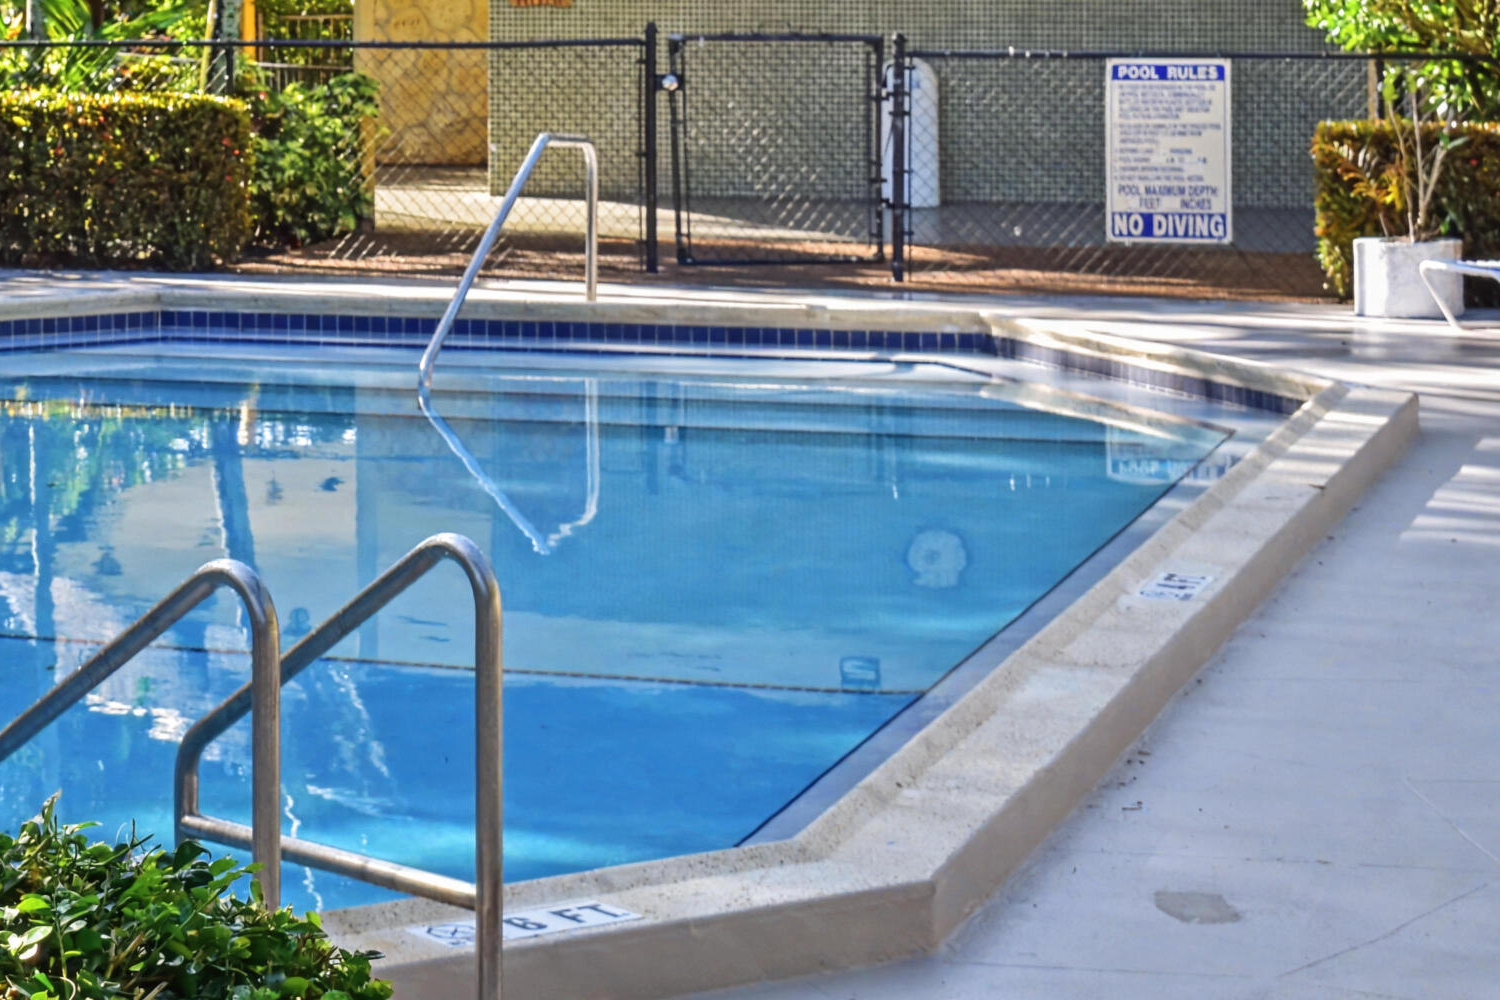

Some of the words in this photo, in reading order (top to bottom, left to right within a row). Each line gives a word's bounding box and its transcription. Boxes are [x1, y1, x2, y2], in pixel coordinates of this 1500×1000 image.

[1118, 65, 1159, 79] POOL
[1167, 66, 1218, 79] RULES
[1118, 184, 1140, 195] POOL
[1114, 214, 1143, 236] NO
[1153, 214, 1224, 237] DIVING
